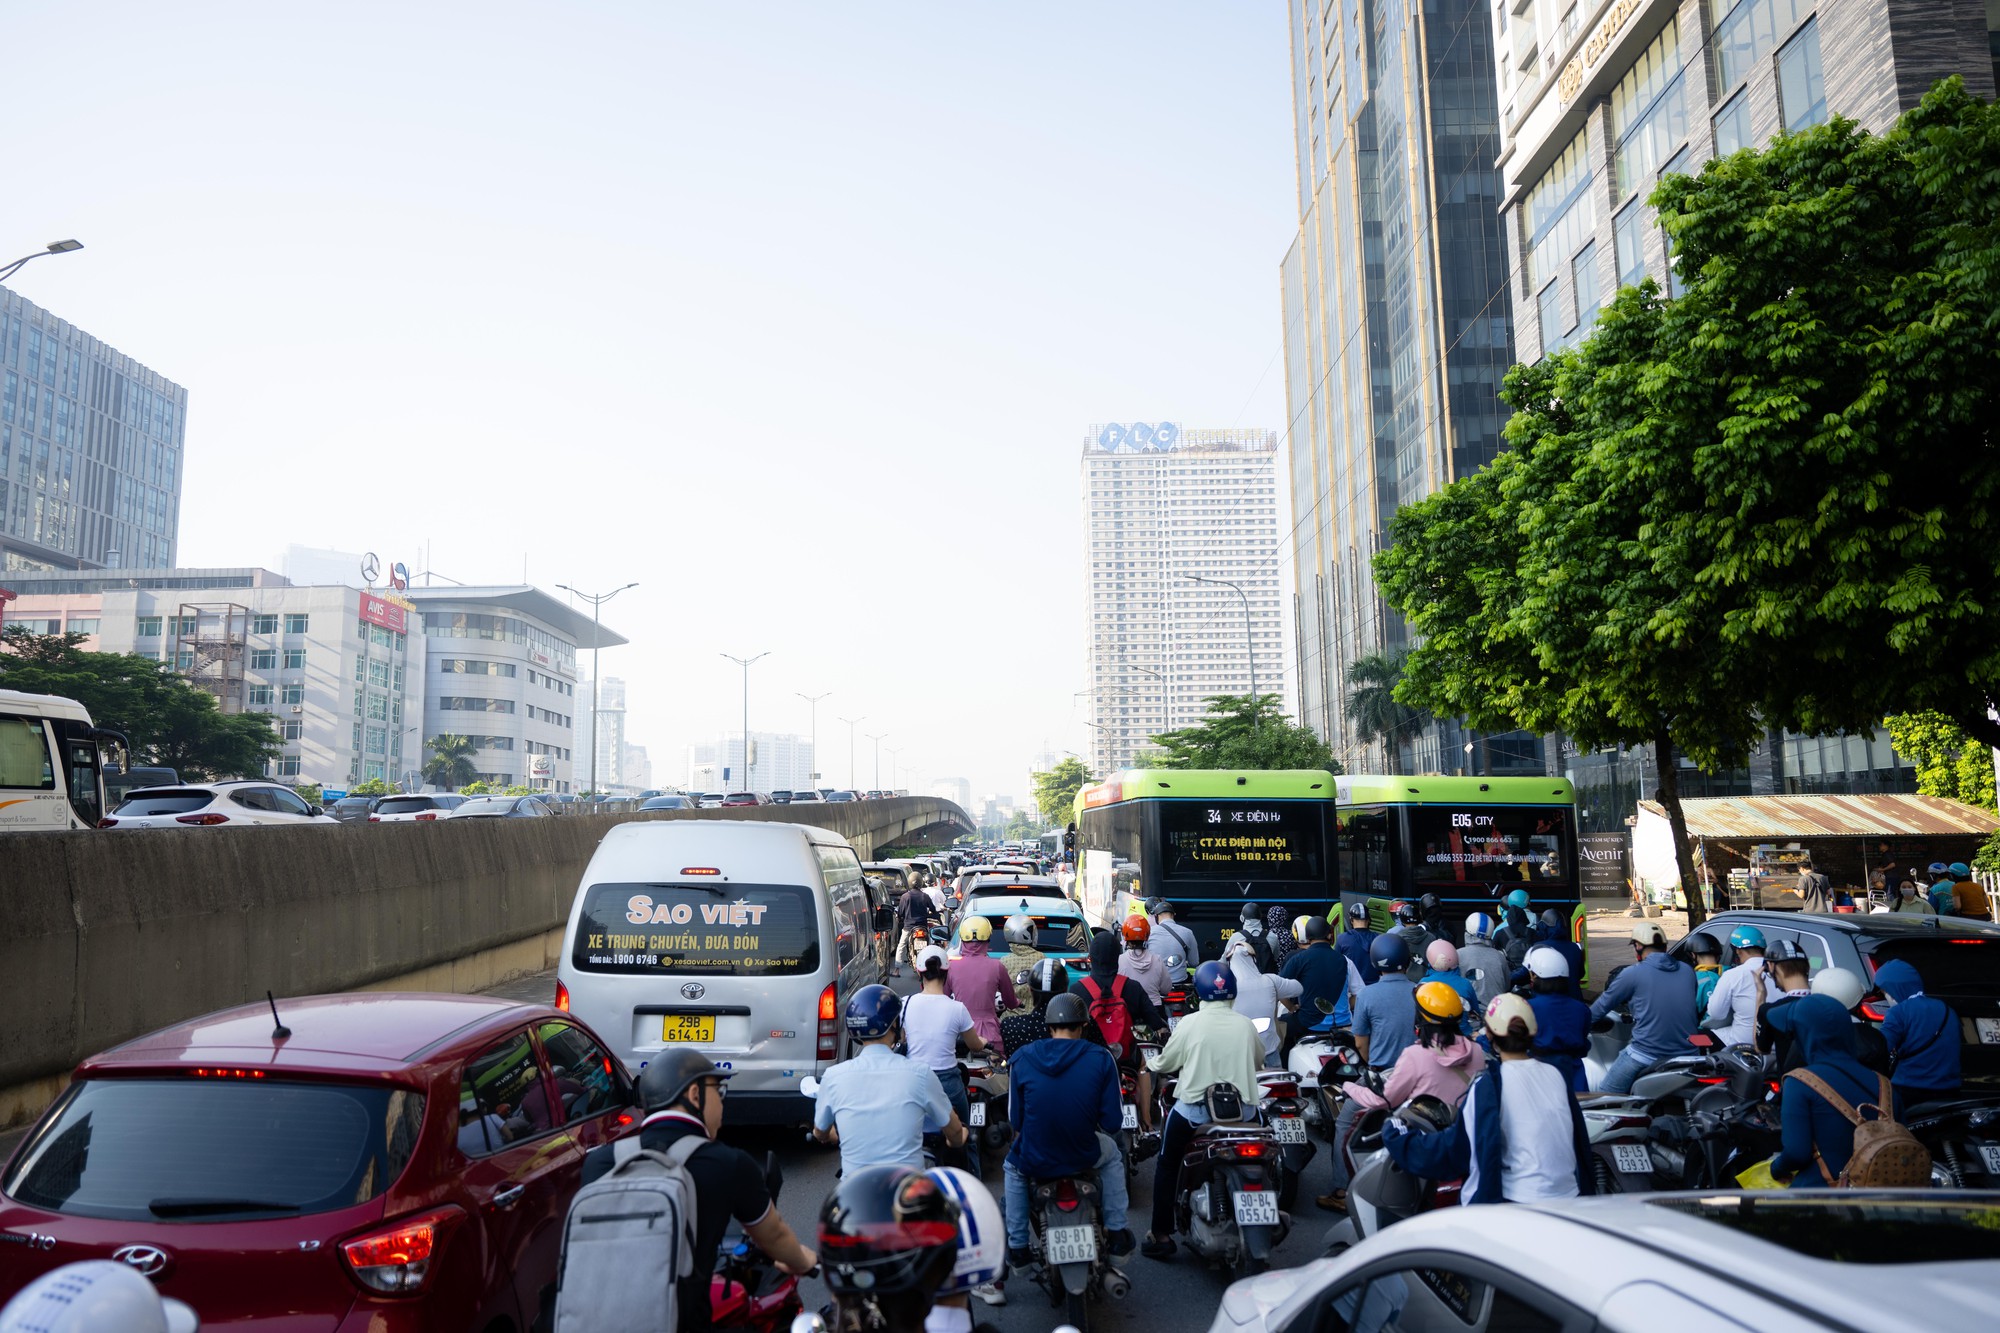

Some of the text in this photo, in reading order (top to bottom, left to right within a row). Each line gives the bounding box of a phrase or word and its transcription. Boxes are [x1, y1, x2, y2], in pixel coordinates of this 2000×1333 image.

[367, 600, 385, 616] AVIS
[1207, 809, 1221, 823] 34
[1231, 812, 1244, 821] XE
[1247, 809, 1268, 823] ĐIỆN
[1452, 814, 1494, 827] E05 CITY
[1200, 838, 1213, 847] CT
[1215, 838, 1227, 847] XE
[1253, 836, 1267, 847] HÀ
[1202, 852, 1292, 861] Hotline 1900.1296
[1427, 855, 1436, 864] GỌI
[1436, 853, 1451, 862] 0866
[1452, 853, 1463, 862] 355
[1463, 853, 1475, 862] 222
[1579, 845, 1624, 863] Avenir
[626, 895, 693, 925] SAO
[588, 929, 759, 951] XE TRUNG CHUYỂN, ĐƯA ĐÓN
[613, 954, 634, 964] 1900
[636, 954, 658, 965] 6746
[673, 958, 740, 966] xesaoviet.com.vn
[754, 958, 765, 966] Xe
[766, 958, 781, 966] Sao
[678, 1016, 701, 1028] 29B
[668, 1029, 709, 1041] 614.13
[1278, 1119, 1301, 1131] 36-B3
[1617, 1146, 1644, 1158] 29-L5
[1619, 1159, 1650, 1171] 239.31
[1241, 1193, 1271, 1208] 90-B4
[1238, 1208, 1276, 1222] 055.47
[1054, 1228, 1086, 1244] 99-B1
[1052, 1243, 1093, 1261] 160.62
